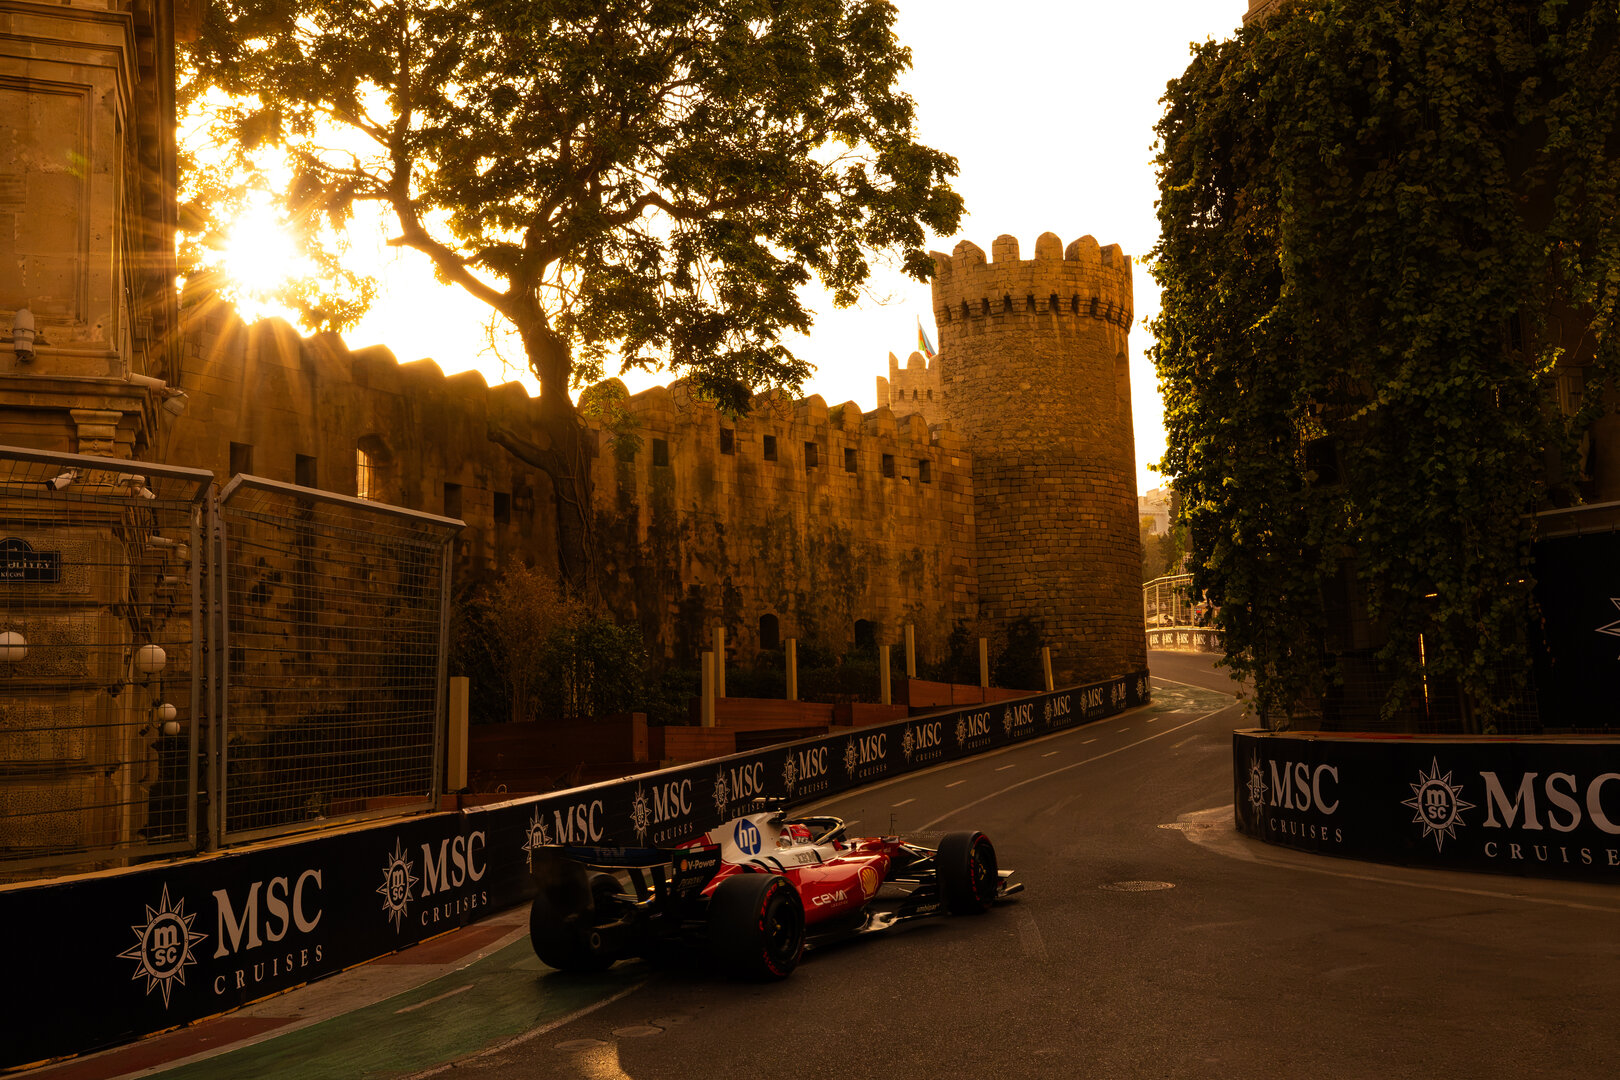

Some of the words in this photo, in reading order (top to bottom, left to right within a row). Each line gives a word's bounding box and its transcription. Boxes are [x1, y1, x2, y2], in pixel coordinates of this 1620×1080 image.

[1053, 695, 1072, 717] MSC
[1087, 687, 1104, 708] MSC
[967, 711, 991, 738] MSC
[1013, 703, 1034, 726] MSC
[858, 733, 888, 765] MSC
[915, 721, 942, 750] MSC
[799, 746, 829, 780] MSC
[858, 763, 888, 779] CRUISES
[730, 761, 765, 801] MSC
[799, 781, 830, 796] CRUISES
[1269, 759, 1340, 815] MSC
[652, 778, 694, 825] MSC
[1479, 771, 1620, 835] MSC
[553, 800, 605, 846] MSC
[653, 821, 695, 844] CRUISES
[738, 818, 759, 856] hp
[1270, 818, 1343, 843] CRUISES
[420, 830, 488, 899] MSC
[687, 858, 717, 871] V-Power
[795, 850, 818, 864] IBM
[1484, 841, 1620, 866] CRUISE
[211, 868, 324, 960] MSC
[421, 891, 489, 927] CRUISES
[213, 944, 324, 996] CRUISES
